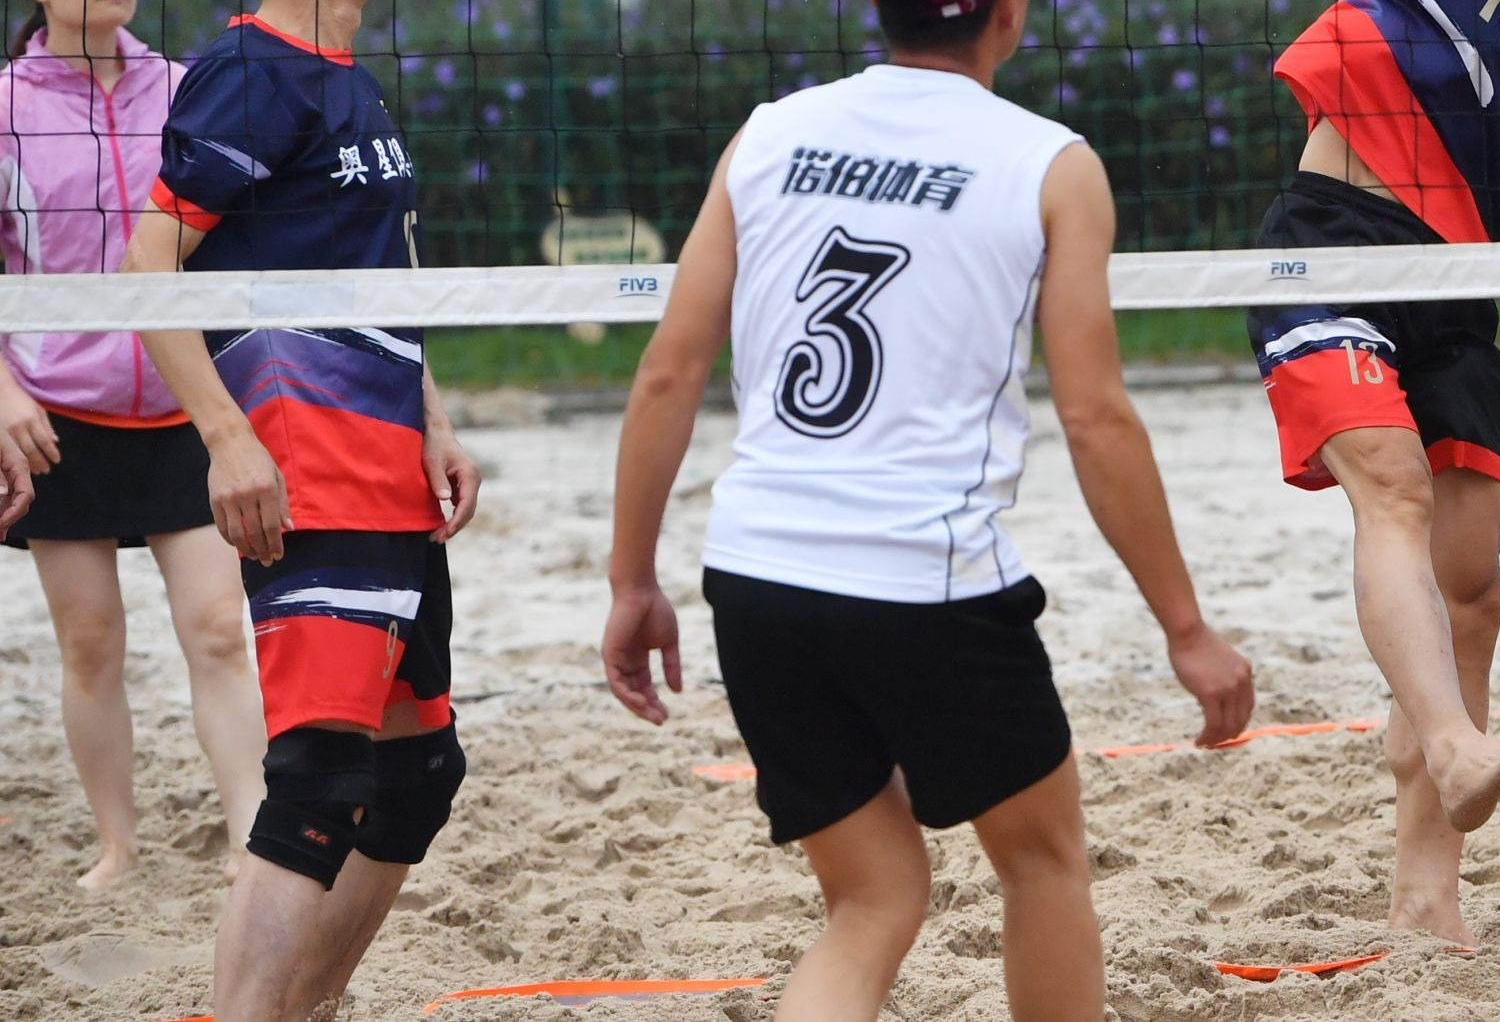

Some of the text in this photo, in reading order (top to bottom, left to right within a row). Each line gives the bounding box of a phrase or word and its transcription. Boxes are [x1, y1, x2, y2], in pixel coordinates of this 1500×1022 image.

[778, 146, 977, 213] 诺伯体育
[619, 277, 658, 292] FIVB
[1271, 261, 1307, 275] FIVB
[772, 224, 911, 439] 3
[1338, 338, 1385, 386] 13
